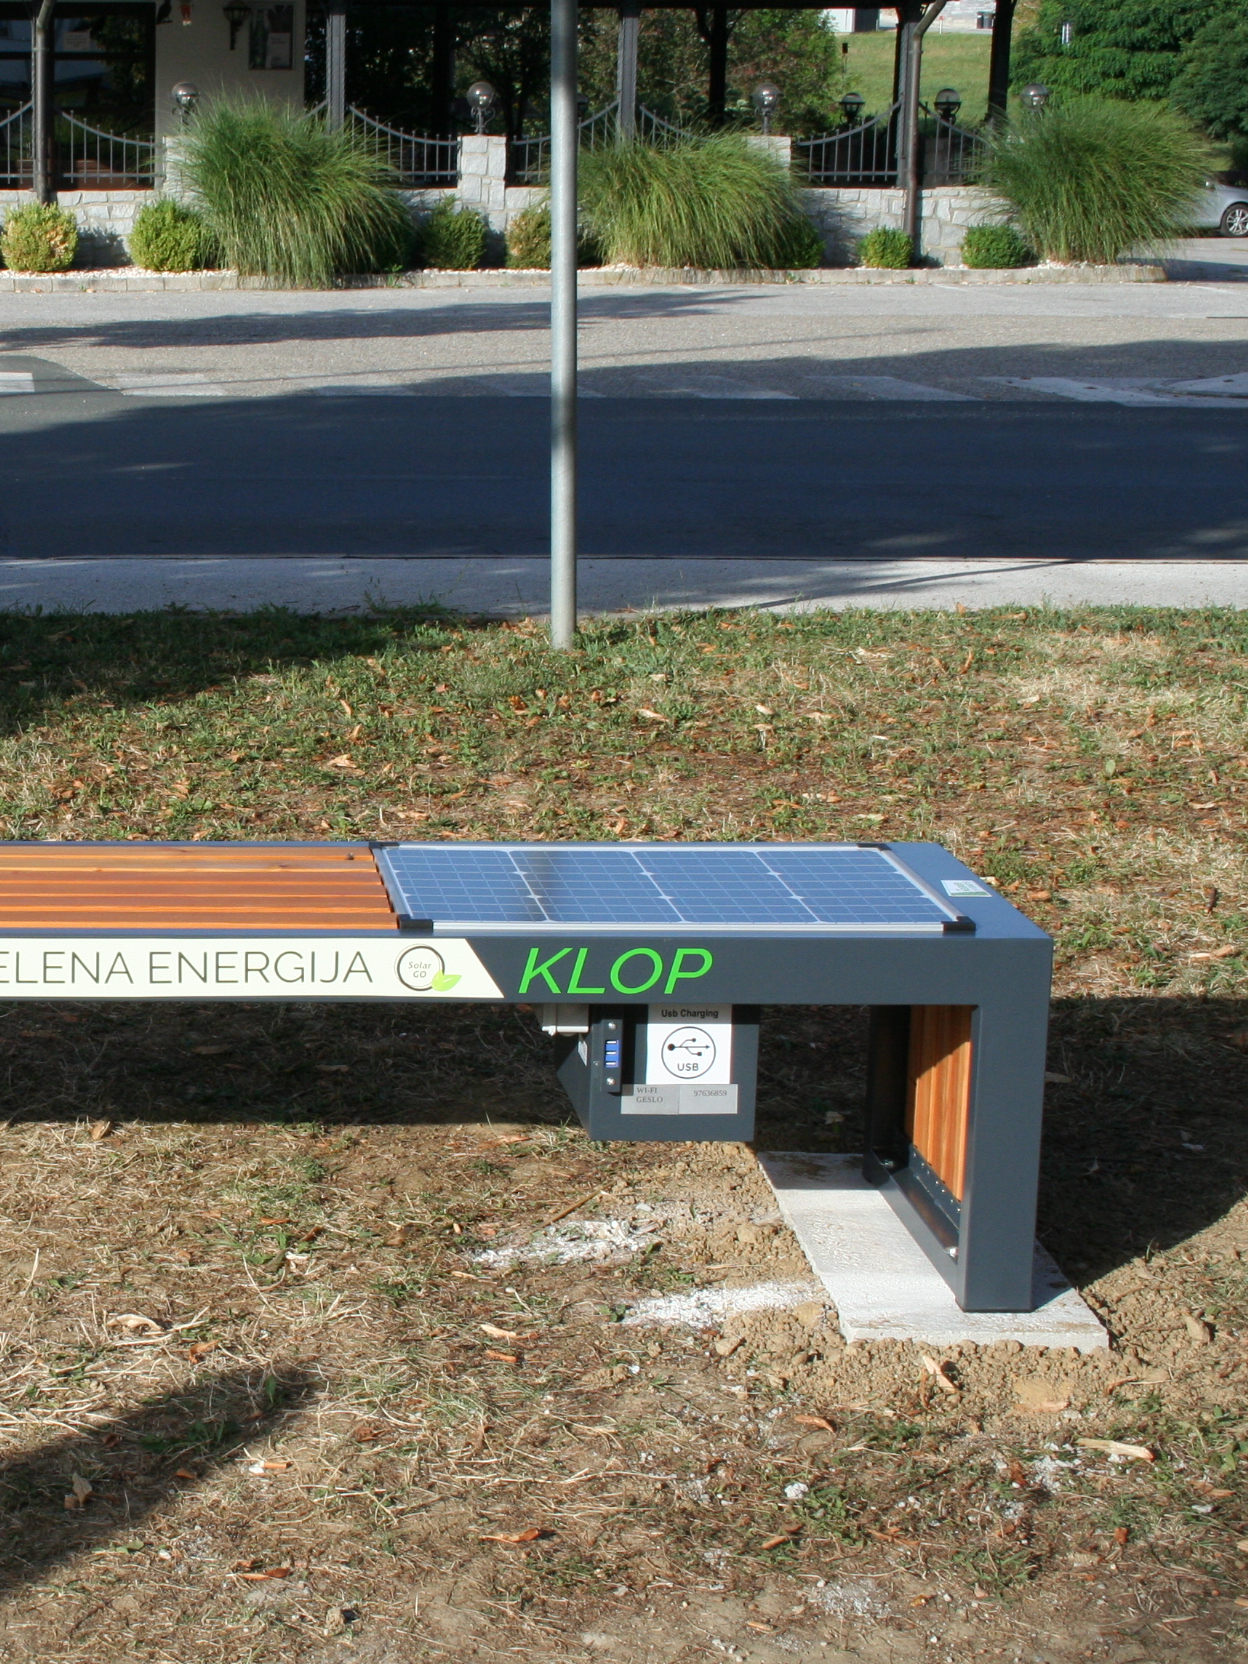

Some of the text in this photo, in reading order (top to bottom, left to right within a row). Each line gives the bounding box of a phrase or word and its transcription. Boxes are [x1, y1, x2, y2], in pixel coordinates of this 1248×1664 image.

[149, 950, 373, 984] ENERGIJA
[408, 961, 432, 970] Solar
[412, 970, 427, 979] GO
[519, 947, 715, 995] KLOP
[661, 1009, 719, 1019] Usb Charging
[677, 1062, 699, 1072] USB
[636, 1086, 658, 1094] WI-FI
